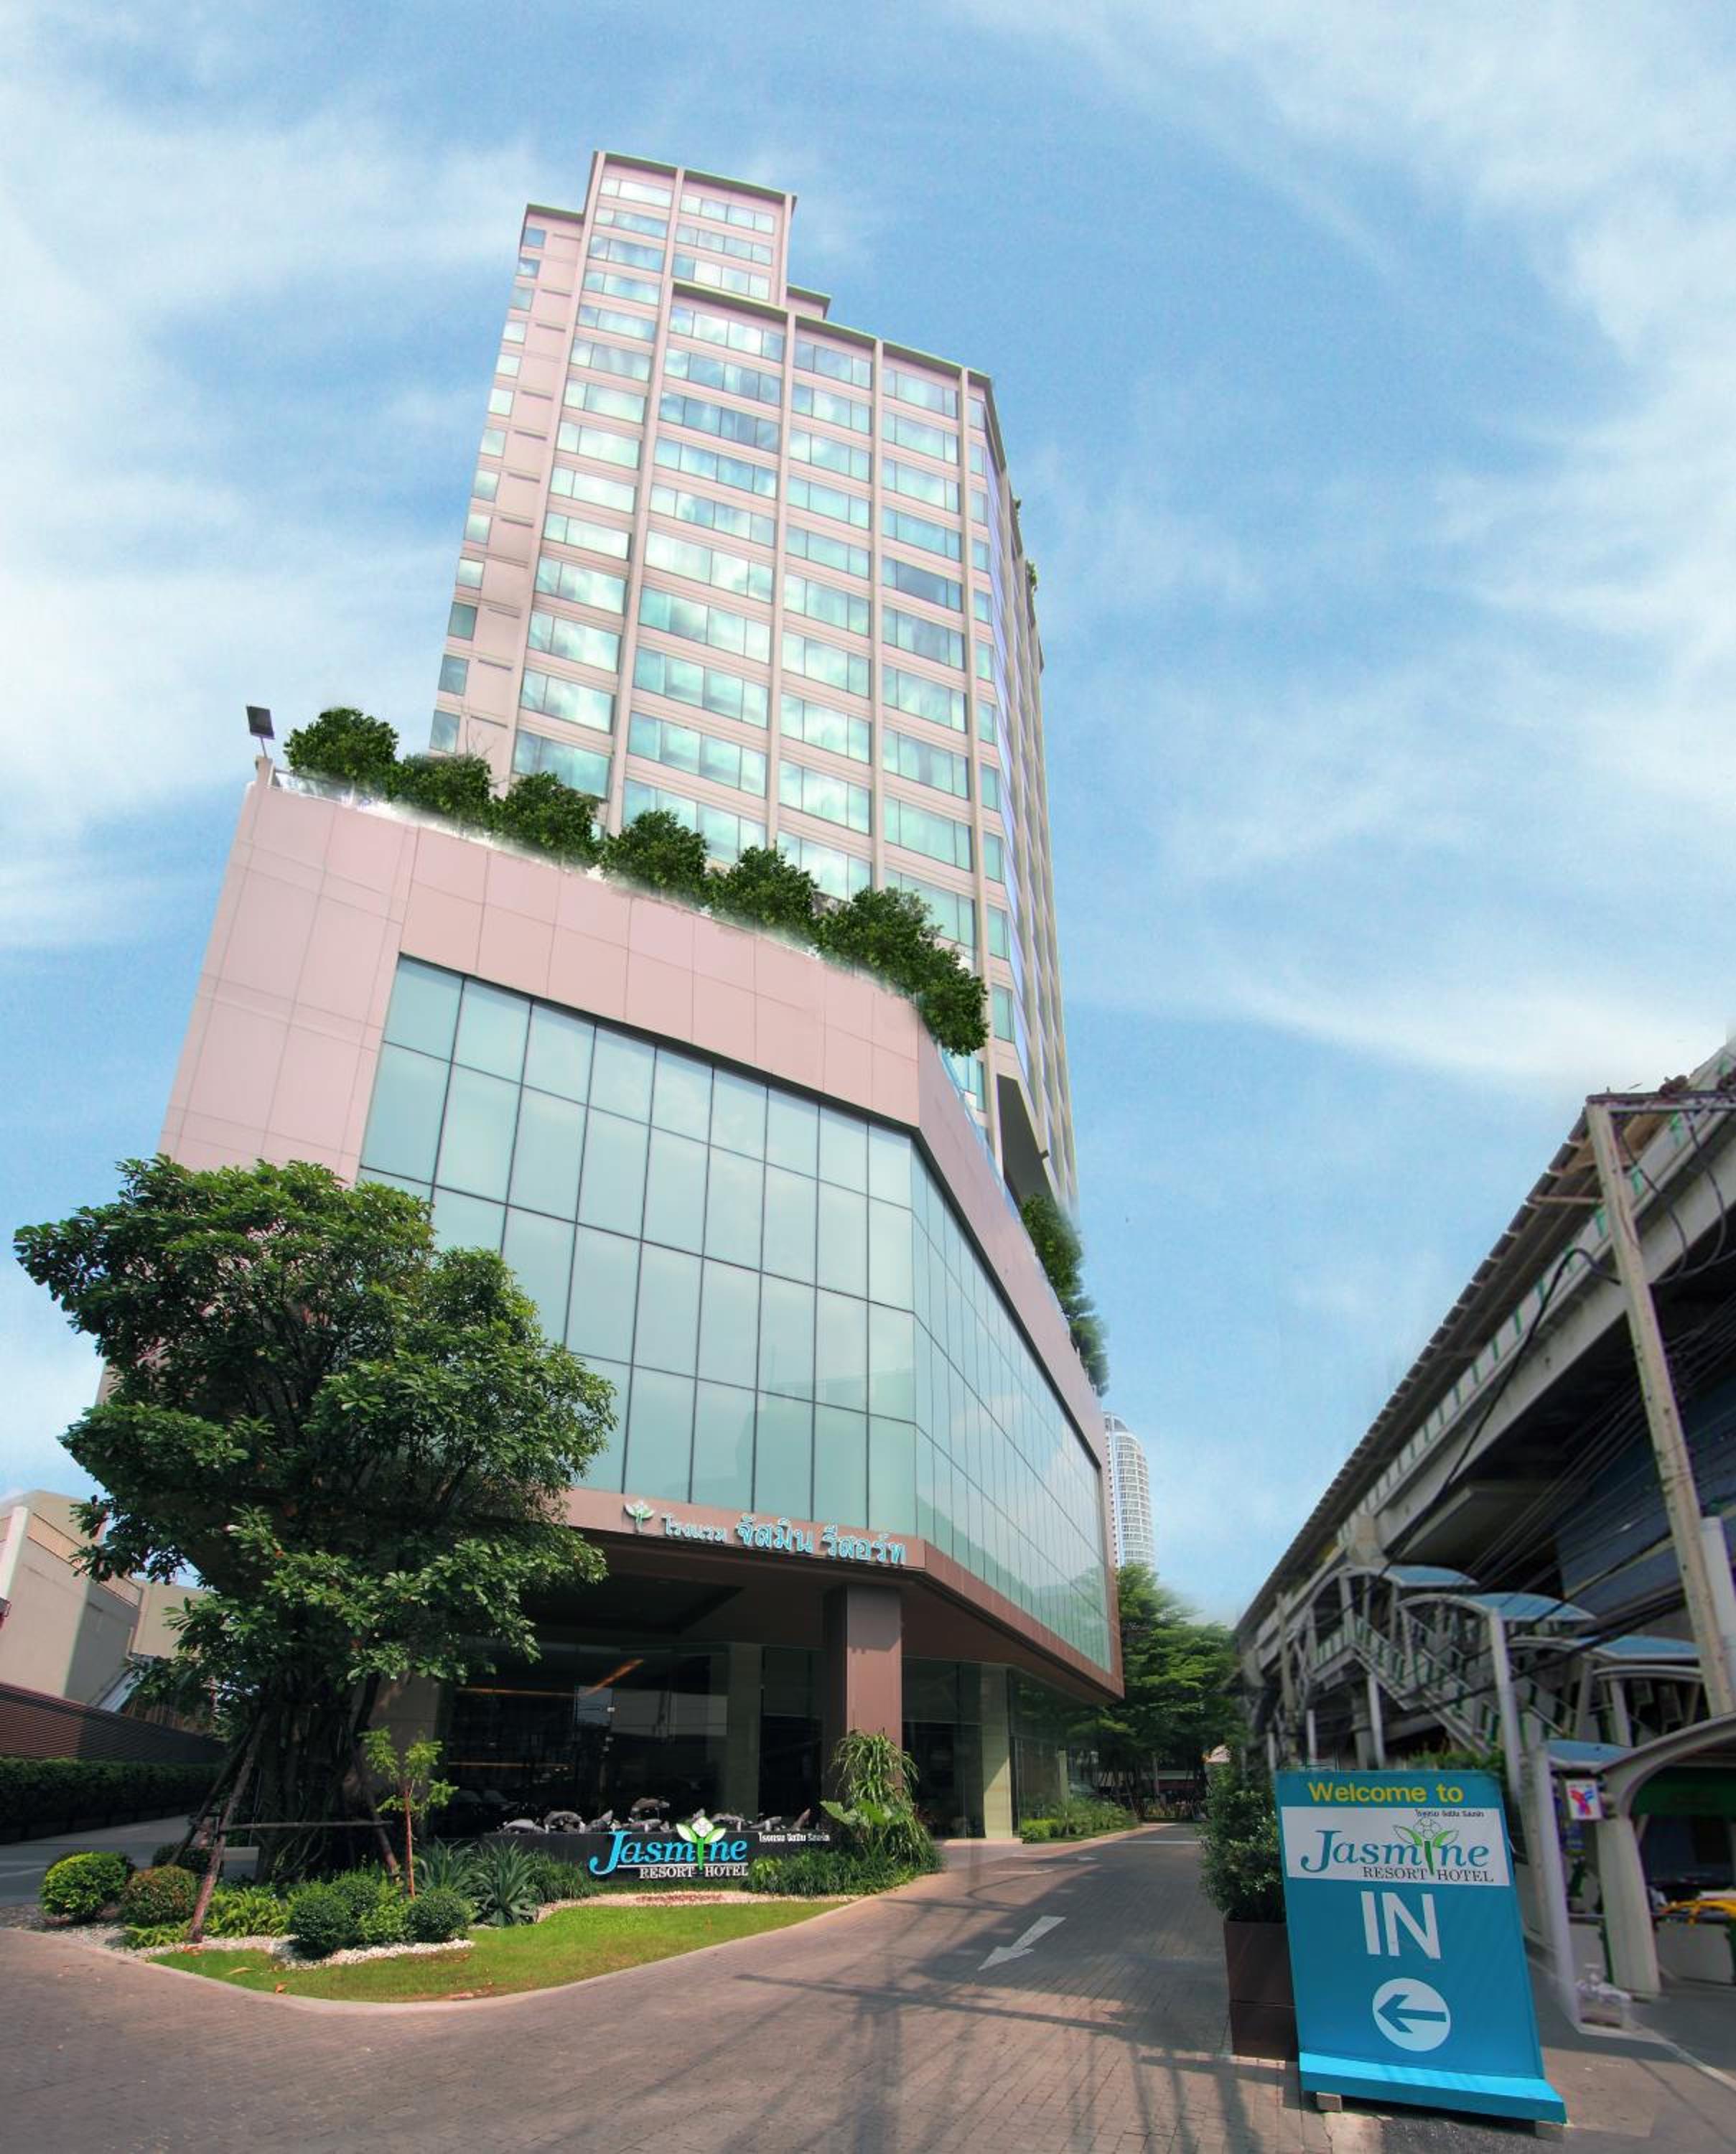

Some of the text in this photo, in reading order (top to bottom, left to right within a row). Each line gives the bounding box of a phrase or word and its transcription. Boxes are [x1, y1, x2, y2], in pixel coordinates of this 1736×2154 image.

[1308, 1782, 1464, 1802] Welcome to
[589, 1830, 748, 1875] Jasmine
[1300, 1830, 1490, 1874] Jasmine
[639, 1865, 748, 1879] RESORT HOTEL
[1363, 1867, 1494, 1882] RESORT HOTEL
[1361, 1891, 1441, 1959] IN
